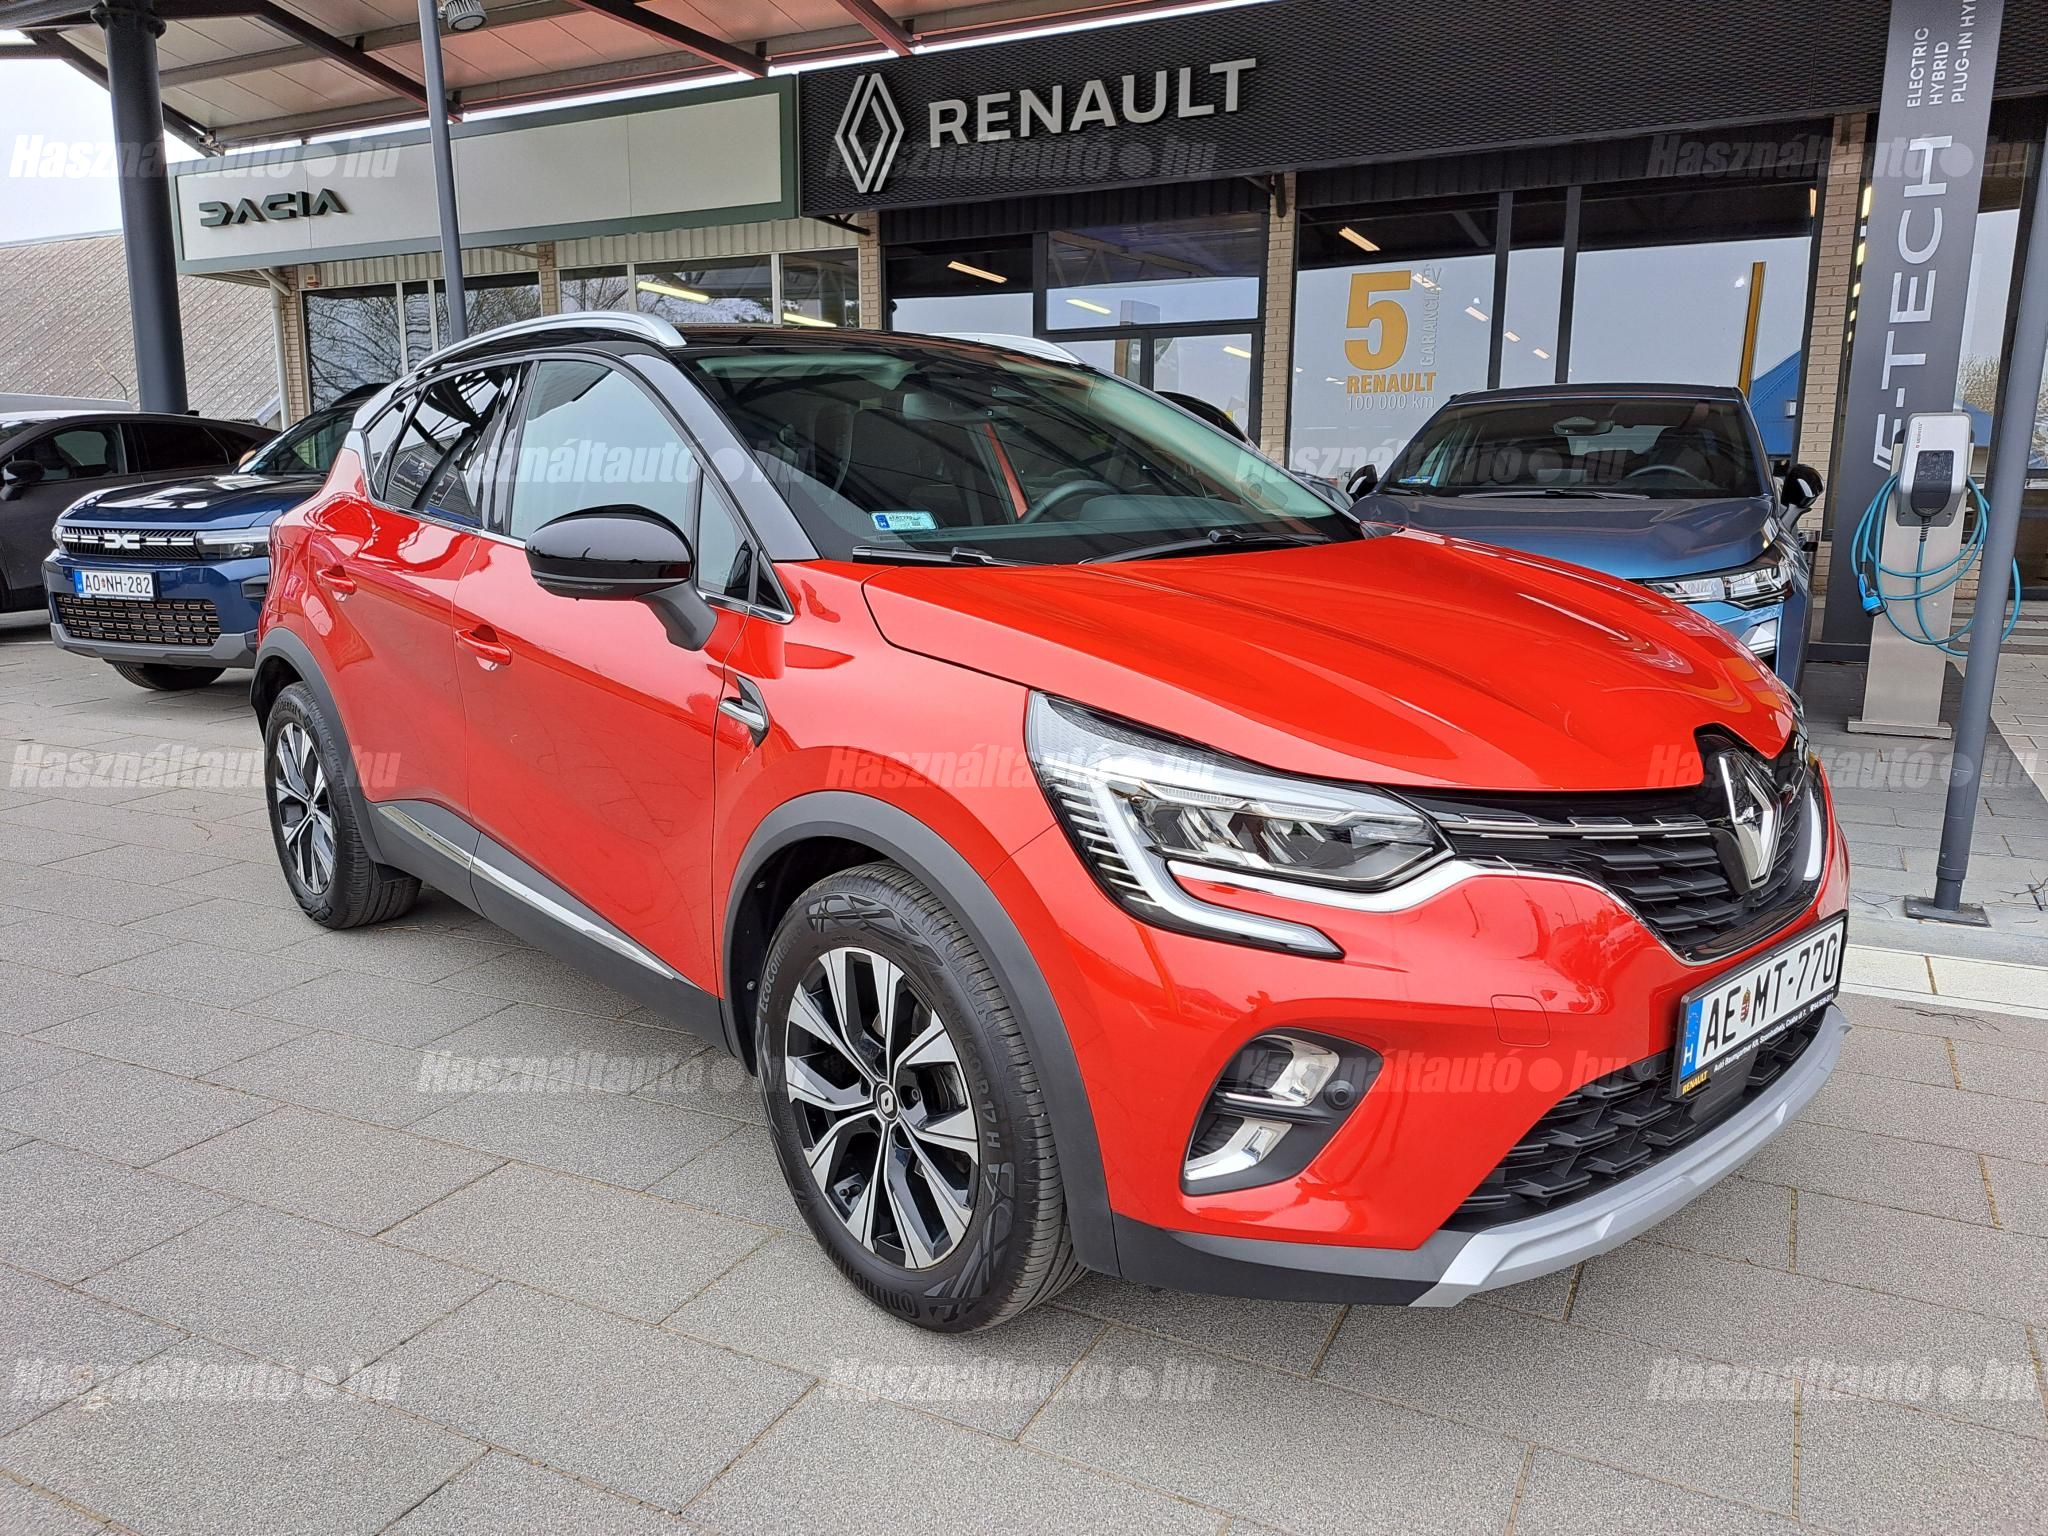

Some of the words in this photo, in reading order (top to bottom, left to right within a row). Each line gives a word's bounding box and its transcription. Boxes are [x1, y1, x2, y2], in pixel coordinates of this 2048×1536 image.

[1960, 0, 1976, 27] HY
[1906, 27, 1929, 107] ELECTRIC
[1928, 41, 1949, 105] HYBRID
[1951, 32, 1973, 103] PLUG-IN
[928, 58, 1257, 149] RENAULT
[199, 187, 347, 227] DACIA
[1344, 270, 1411, 371] 5
[1420, 284, 1440, 367] GARANCIA
[1346, 371, 1437, 394] RENAULT
[1349, 395, 1375, 411] 100
[1379, 393, 1407, 410] 000
[1412, 392, 1435, 409] km
[1702, 985, 1742, 1057] AE
[1682, 1071, 1709, 1095] RENAULT
